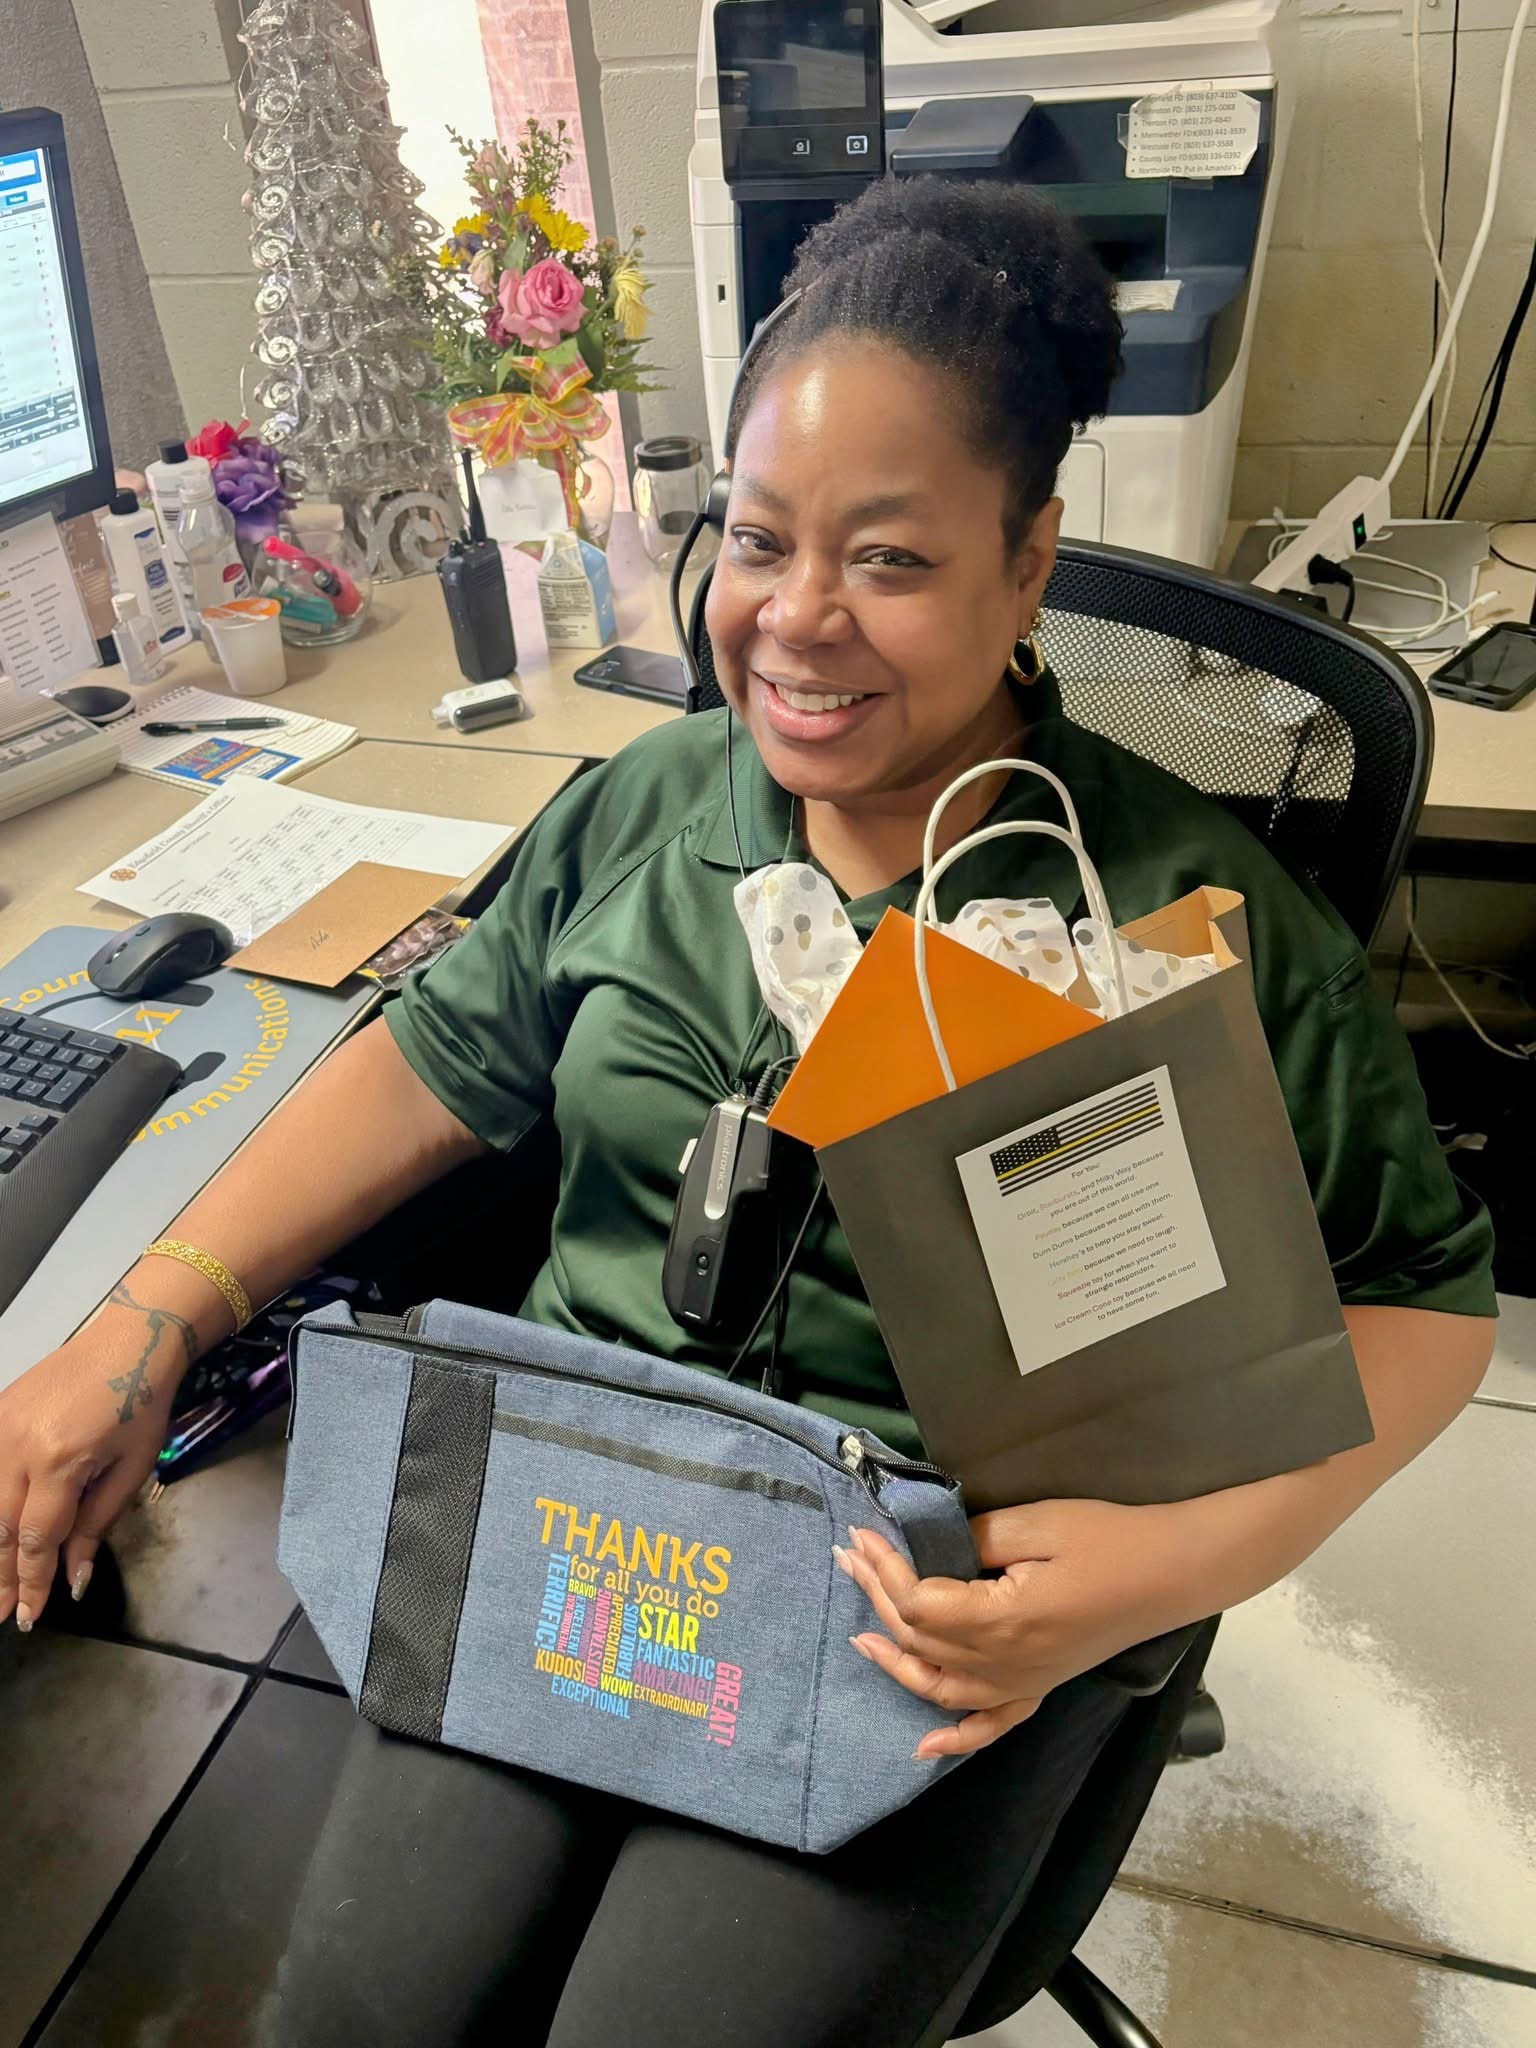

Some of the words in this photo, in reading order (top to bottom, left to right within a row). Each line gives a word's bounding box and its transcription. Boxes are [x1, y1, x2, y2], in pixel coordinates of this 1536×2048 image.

[115, 1008, 182, 1044] 11
[130, 977, 290, 1142] mmunications
[716, 1123, 734, 1193] plantronics
[1071, 1169, 1083, 1178] For
[1081, 1181, 1095, 1192] and
[1095, 1173, 1114, 1185] Milky
[1115, 1166, 1131, 1176] Way
[1132, 1151, 1163, 1168] because
[1049, 1208, 1063, 1218] you
[1064, 1201, 1077, 1210] are
[1077, 1194, 1090, 1204] out
[1091, 1190, 1098, 1198] of
[1099, 1185, 1113, 1194] this
[1062, 1211, 1093, 1228] because
[1094, 1206, 1105, 1214] we
[1106, 1199, 1120, 1208] can
[1120, 1193, 1130, 1202] all
[1130, 1188, 1144, 1197] use
[1145, 1181, 1159, 1191] one
[1074, 1223, 1105, 1240] because
[1105, 1217, 1117, 1226] we
[1118, 1209, 1134, 1220] deal
[1134, 1202, 1150, 1213] with
[1084, 1253, 1115, 1270] because
[1127, 1238, 1145, 1250] need
[1094, 1238, 1111, 1248] help
[1111, 1231, 1125, 1242] you
[1126, 1224, 1141, 1234] stay
[1091, 1275, 1103, 1284] toy
[1104, 1270, 1114, 1279] for
[1115, 1261, 1135, 1273] when
[1135, 1255, 1149, 1265] you
[1149, 1245, 1168, 1257] want
[1066, 1309, 1092, 1323] Cream
[1092, 1300, 1112, 1312] Cone
[1112, 1294, 1123, 1302] toy
[1124, 1280, 1155, 1297] because
[1156, 1275, 1166, 1283] we
[1167, 1269, 1177, 1278] all
[1177, 1261, 1196, 1273] need
[1085, 1282, 1113, 1298] strangle
[1106, 1305, 1124, 1316] have
[1124, 1296, 1144, 1308] some
[535, 1497, 732, 1595] THANKS
[533, 1552, 571, 1652] TERRIFIC!
[568, 1578, 598, 1600] BRAVO!
[569, 1554, 600, 1582] for
[604, 1561, 630, 1595] all
[634, 1580, 680, 1609] you
[686, 1591, 719, 1619] do
[566, 1596, 587, 1658] EXCELLENT
[584, 1587, 612, 1688] OUTSTANDING
[602, 1593, 624, 1675] APPRECIATED
[615, 1603, 639, 1680] FABULOUS
[637, 1603, 700, 1654] STAR
[535, 1648, 588, 1684] KUDOS!
[635, 1638, 716, 1681] FANTASTIC
[551, 1676, 631, 1720] EXCEPTIONAL
[599, 1673, 634, 1699] WOW!
[632, 1662, 713, 1702] AMAZING!
[633, 1685, 710, 1719] EXTRAORDINARY
[706, 1661, 743, 1748] GREAT!
